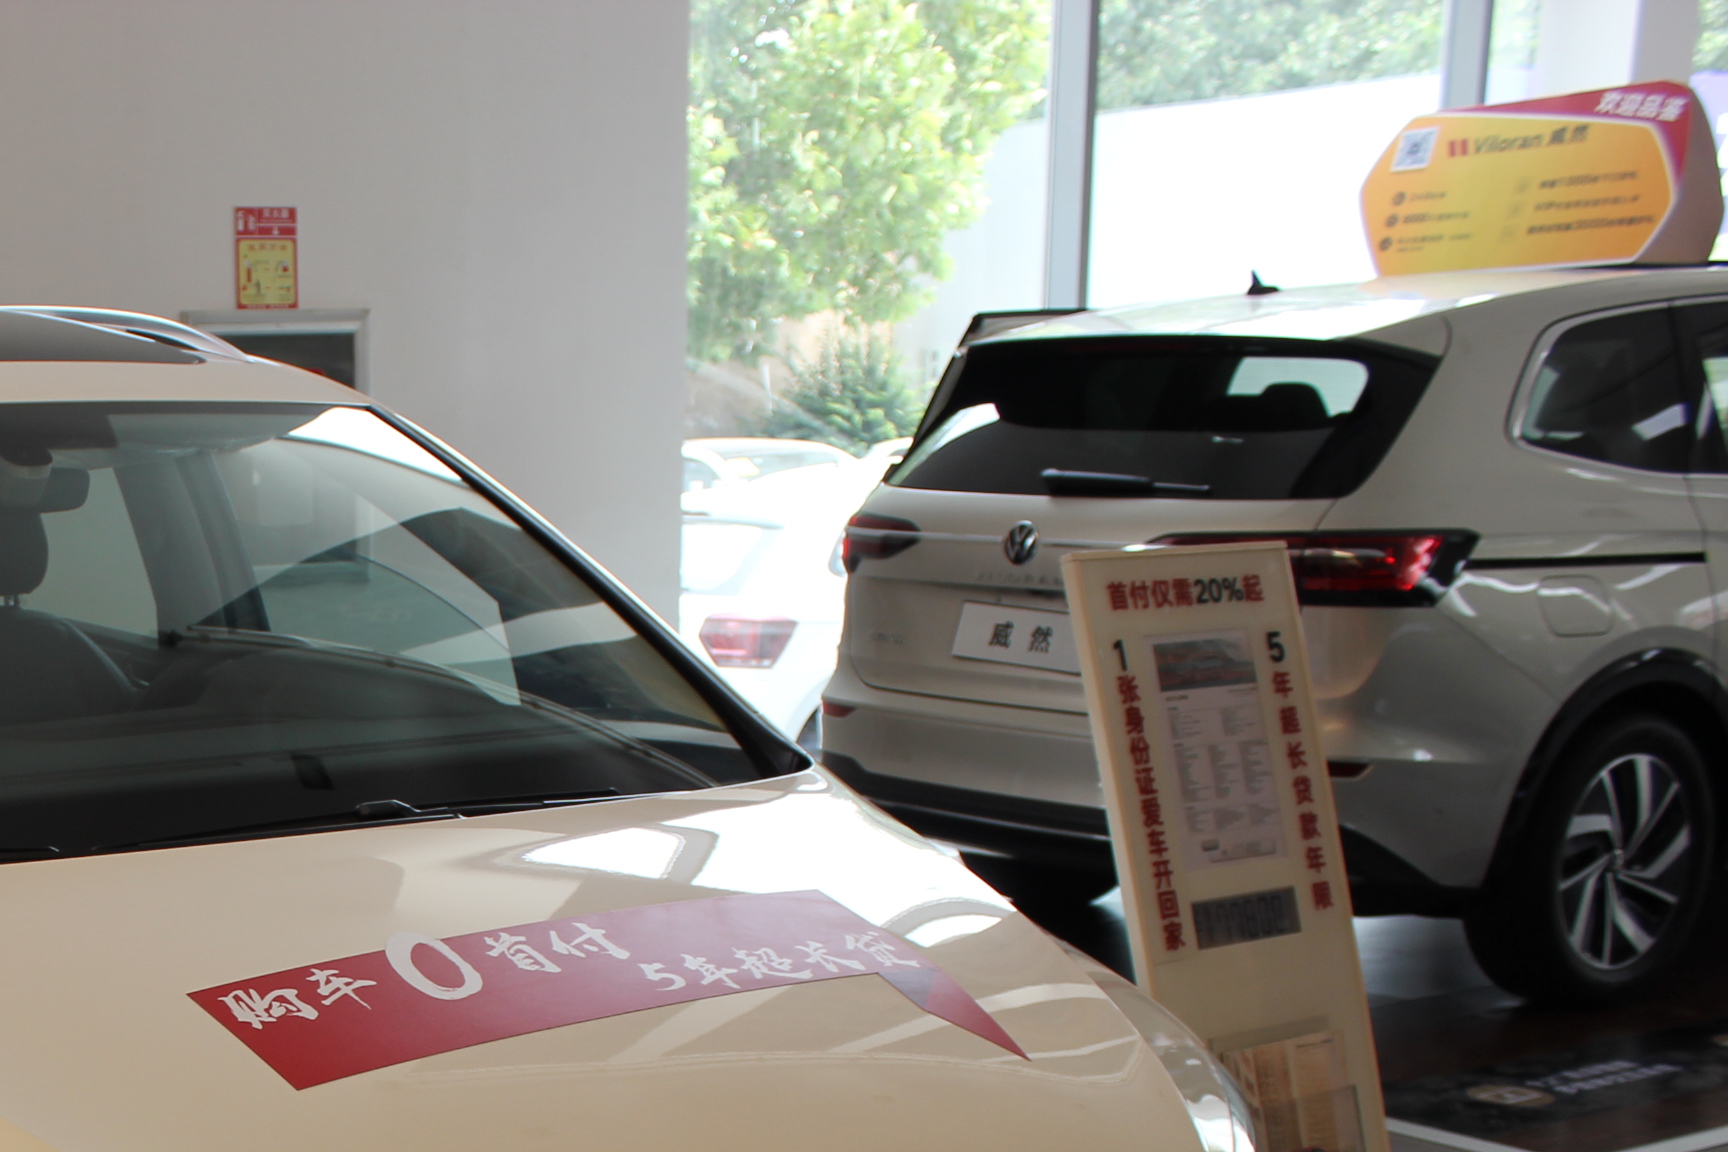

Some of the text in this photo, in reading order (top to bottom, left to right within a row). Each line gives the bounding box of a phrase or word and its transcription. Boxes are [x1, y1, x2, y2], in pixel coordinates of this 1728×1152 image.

[1107, 574, 1265, 611] 首付仅需20%起
[988, 621, 1053, 653] 威然
